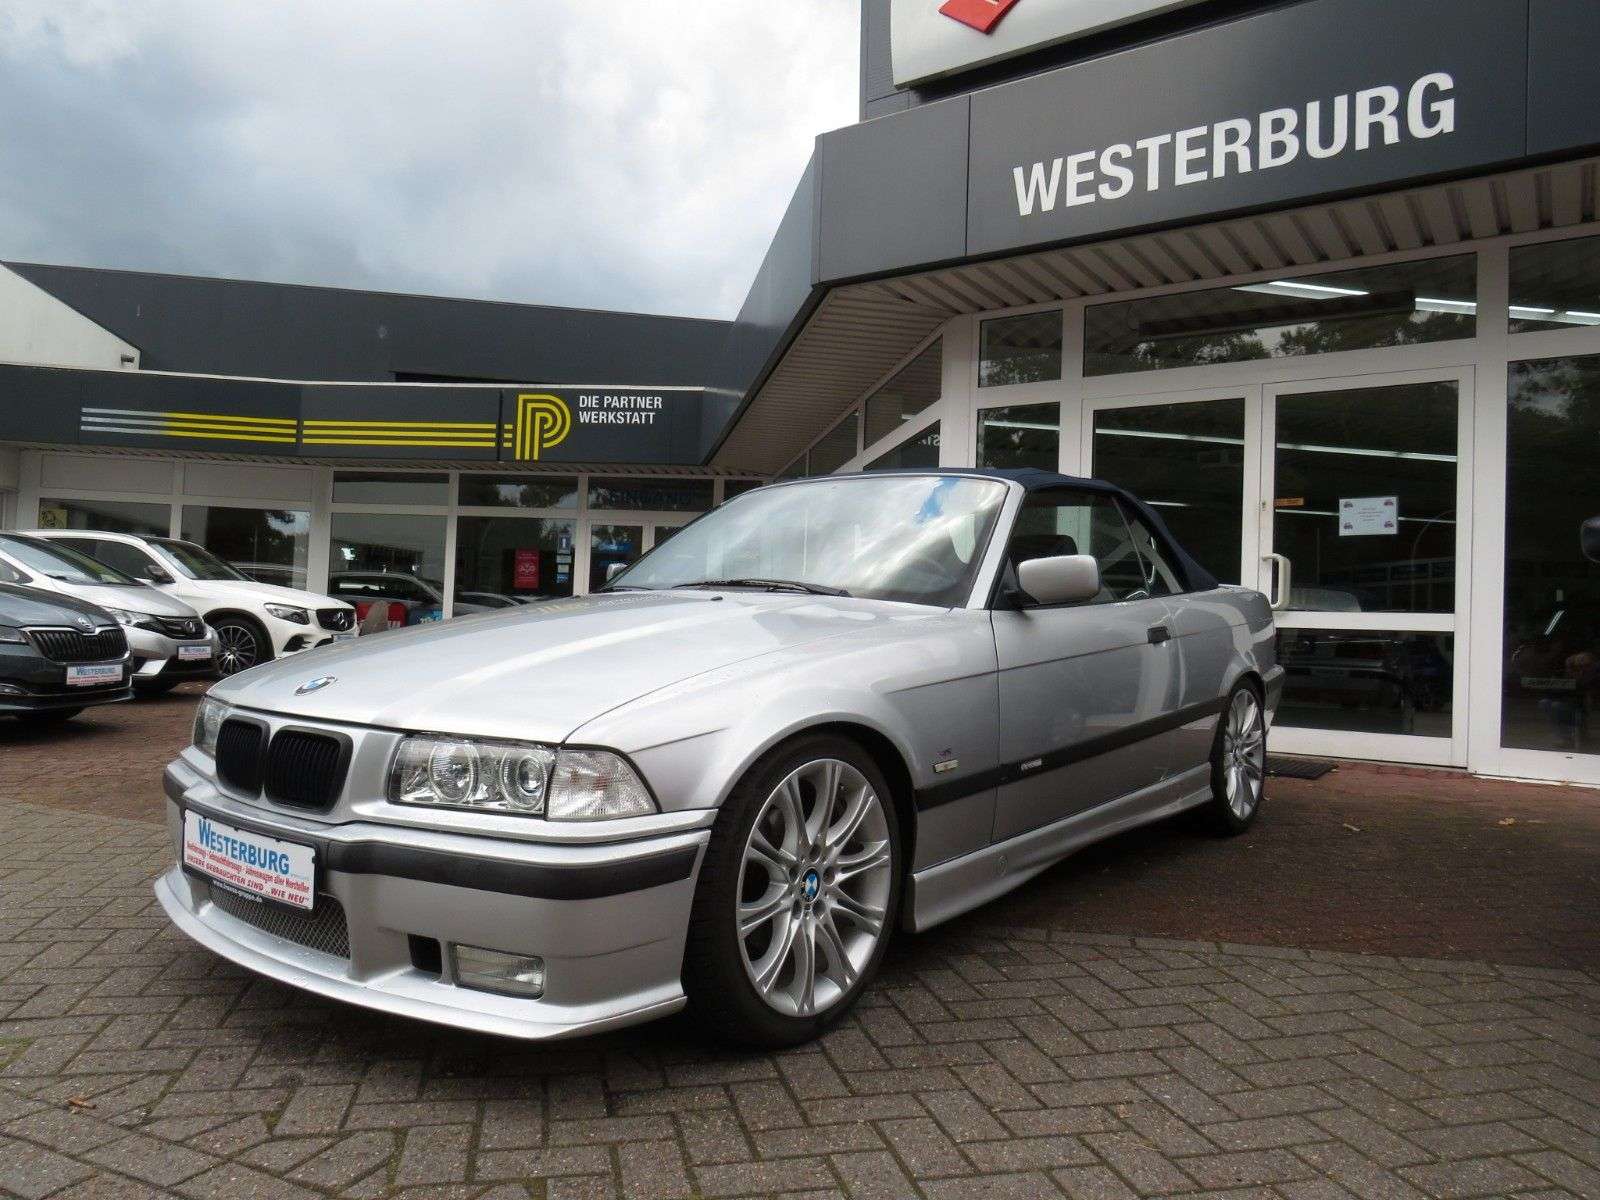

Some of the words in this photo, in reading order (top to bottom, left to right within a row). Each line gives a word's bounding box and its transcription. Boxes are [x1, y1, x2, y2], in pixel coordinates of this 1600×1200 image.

[1013, 72, 1456, 216] WESTERBURG
[579, 395, 600, 408] DIE
[603, 395, 663, 409] PARTNER
[579, 411, 656, 425] WERKSTATT
[199, 818, 290, 875] WESTERBURG
